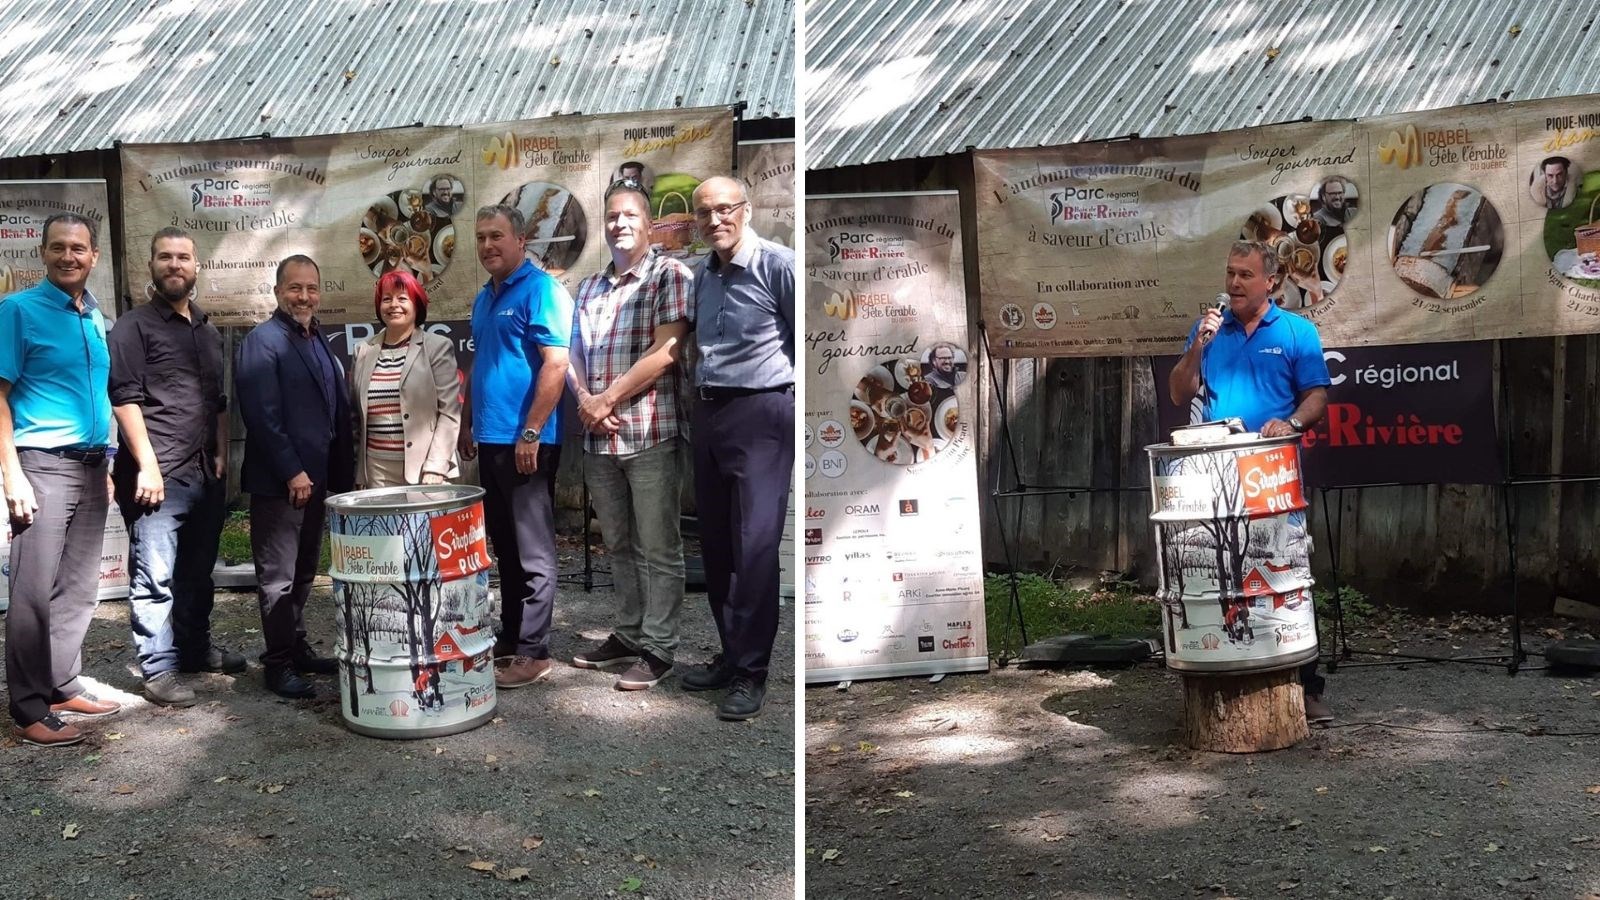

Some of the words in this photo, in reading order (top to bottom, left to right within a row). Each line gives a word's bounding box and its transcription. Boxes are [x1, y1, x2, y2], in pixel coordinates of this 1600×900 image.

[624, 125, 676, 141] PIQUE-NIQUE
[1546, 113, 1600, 132] PIQUE-NIQU
[360, 145, 411, 163] Souper
[525, 149, 550, 168] Fête
[1240, 143, 1297, 165] Souper
[1429, 146, 1459, 167] Fête
[1462, 144, 1507, 162] l'érable
[138, 161, 221, 192] L'automne
[224, 160, 304, 176] gourmand
[306, 168, 326, 186] du
[388, 150, 462, 181] gourmand
[744, 162, 795, 188] L'auto
[1270, 147, 1356, 185] gourmand
[1469, 163, 1479, 171] DU
[1480, 160, 1508, 171] QUÉBEC
[204, 178, 239, 190] Parc
[993, 165, 1083, 204] L'automne
[1087, 165, 1177, 182] gourmand
[1178, 172, 1201, 193] du
[1065, 187, 1104, 200] Parc
[1107, 190, 1139, 200] régional
[17, 199, 85, 214] gourmand
[88, 208, 103, 222] du
[171, 211, 179, 227] à
[183, 218, 231, 232] saveur
[235, 210, 296, 231] d'érable
[858, 214, 934, 231] gourmand
[937, 221, 955, 239] du
[1028, 224, 1036, 243] à
[1042, 232, 1093, 248] saveur
[1099, 221, 1167, 247] d'érable
[840, 232, 874, 244] Parc
[200, 259, 265, 270] ollaboration
[809, 263, 817, 278] à
[822, 269, 871, 282] saveur
[873, 261, 929, 281] d'érable
[325, 280, 345, 292] BNI
[1037, 281, 1053, 293] En
[1056, 277, 1132, 292] collaboration
[1135, 278, 1160, 289] avec
[862, 304, 884, 319] Fête
[1310, 297, 1336, 319] Picard
[1411, 298, 1441, 314] 21/22
[1442, 295, 1487, 315] septembre
[818, 336, 919, 375] gourmand
[1355, 360, 1460, 390] régional
[1302, 402, 1463, 449] e-Rivière
[805, 490, 848, 498] ollaboration
[1267, 492, 1295, 513] PUR
[458, 552, 484, 575] PUR
